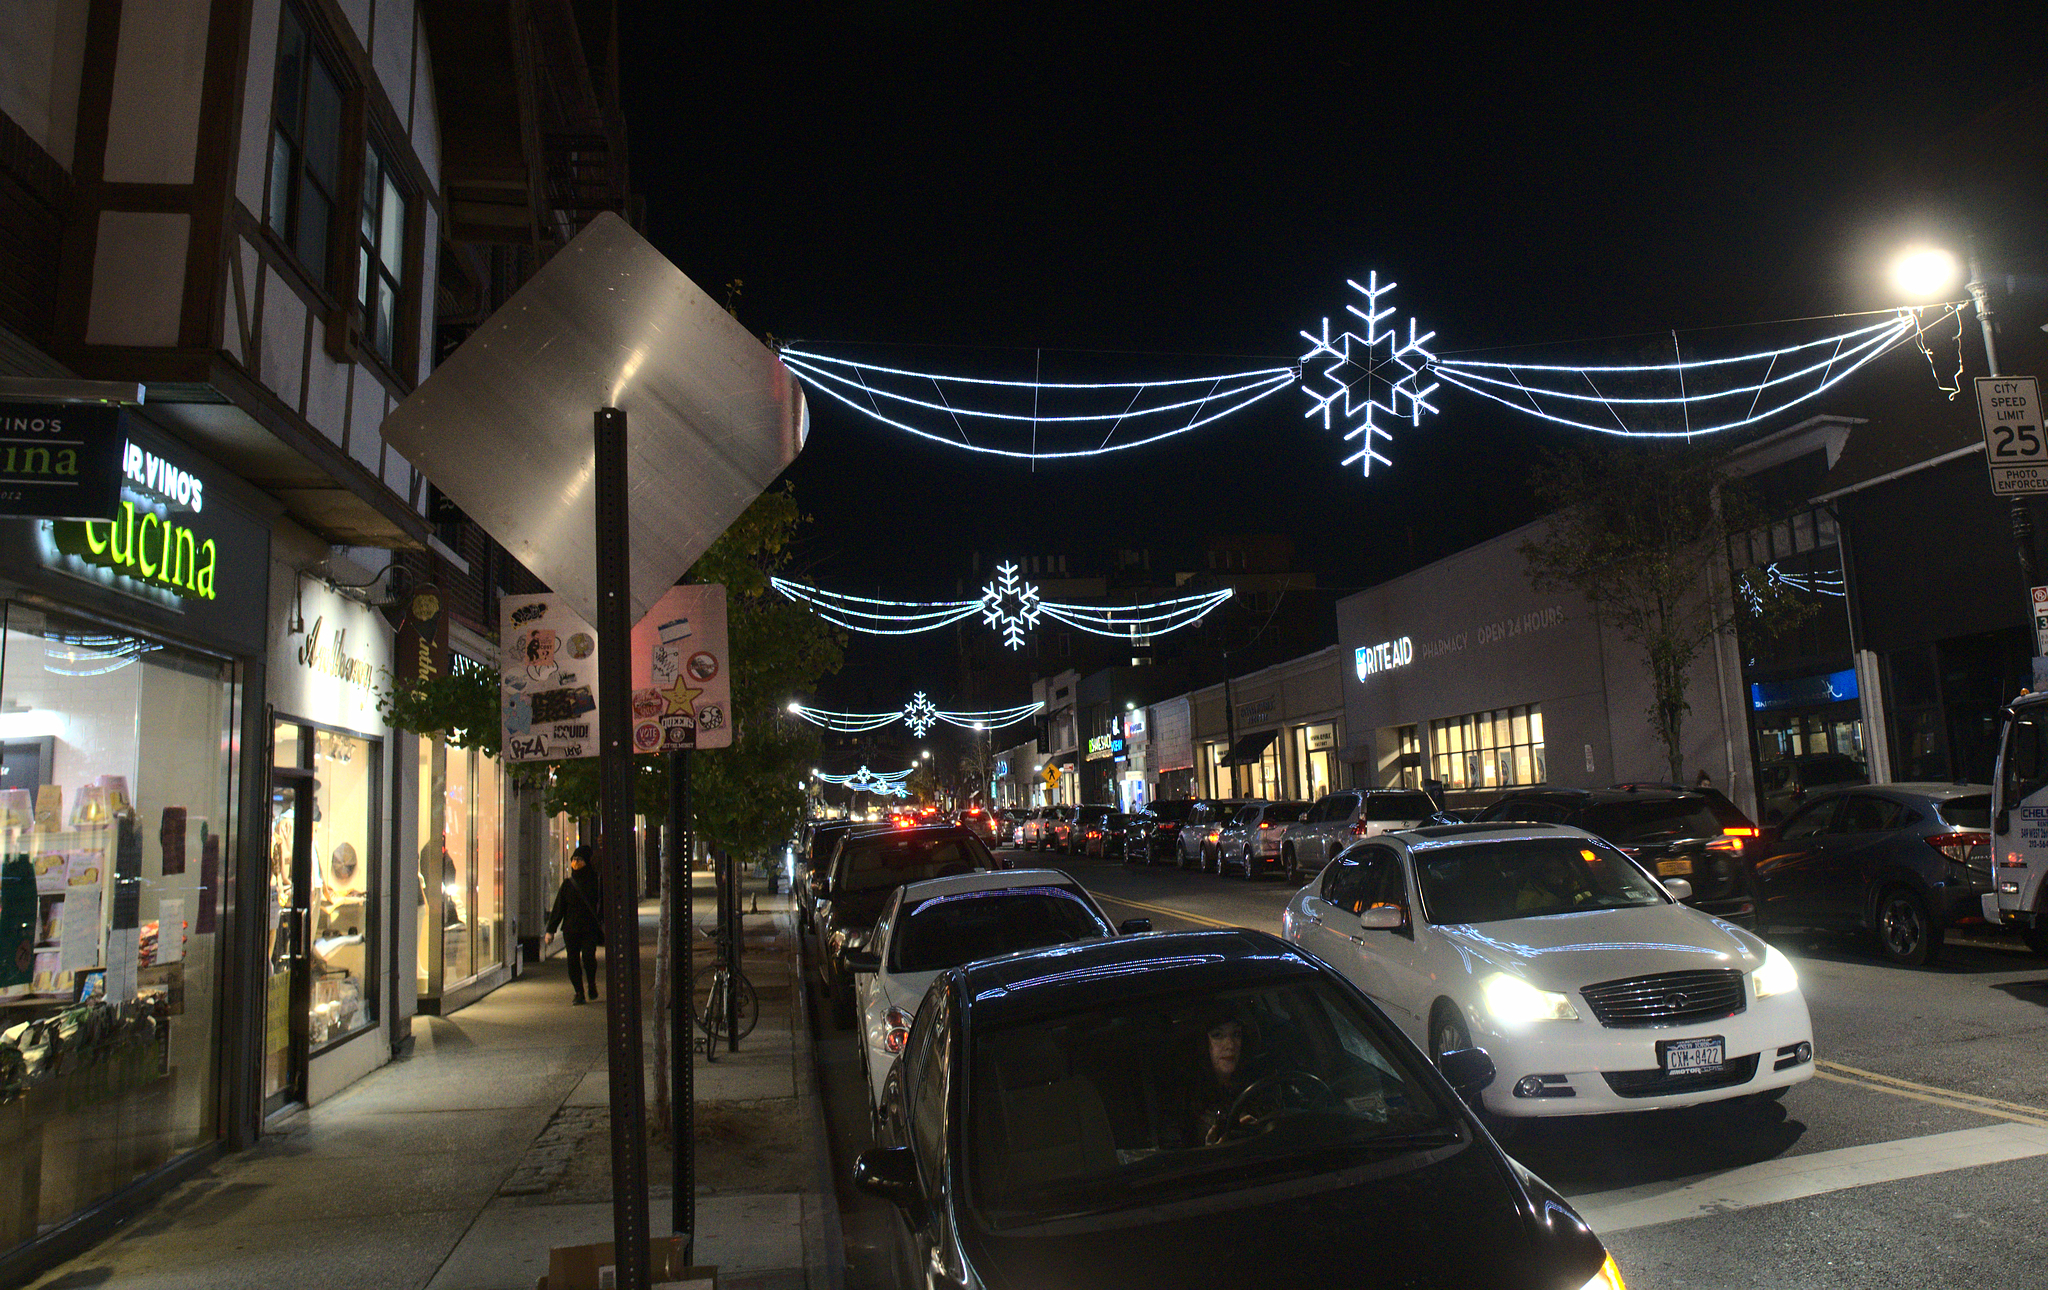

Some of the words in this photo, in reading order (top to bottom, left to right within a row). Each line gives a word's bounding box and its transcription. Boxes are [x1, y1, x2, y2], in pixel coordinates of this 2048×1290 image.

[1994, 384, 2018, 393] CITY
[1991, 397, 2027, 407] SPEED
[1997, 410, 2025, 420] LIMIT
[0, 417, 61, 432] INO'S
[1993, 425, 2040, 457] 25
[2006, 470, 2038, 479] PHOTO
[1998, 479, 2048, 490] ENFORCED
[1478, 621, 1506, 645] OPEN
[1508, 617, 1522, 638] 24
[1523, 605, 1564, 633] HOURS
[1422, 632, 1468, 659] PHARMACY
[640, 727, 657, 738] VOTE
[1671, 1050, 1689, 1067] CXM
[1695, 1048, 1718, 1065] 8422
